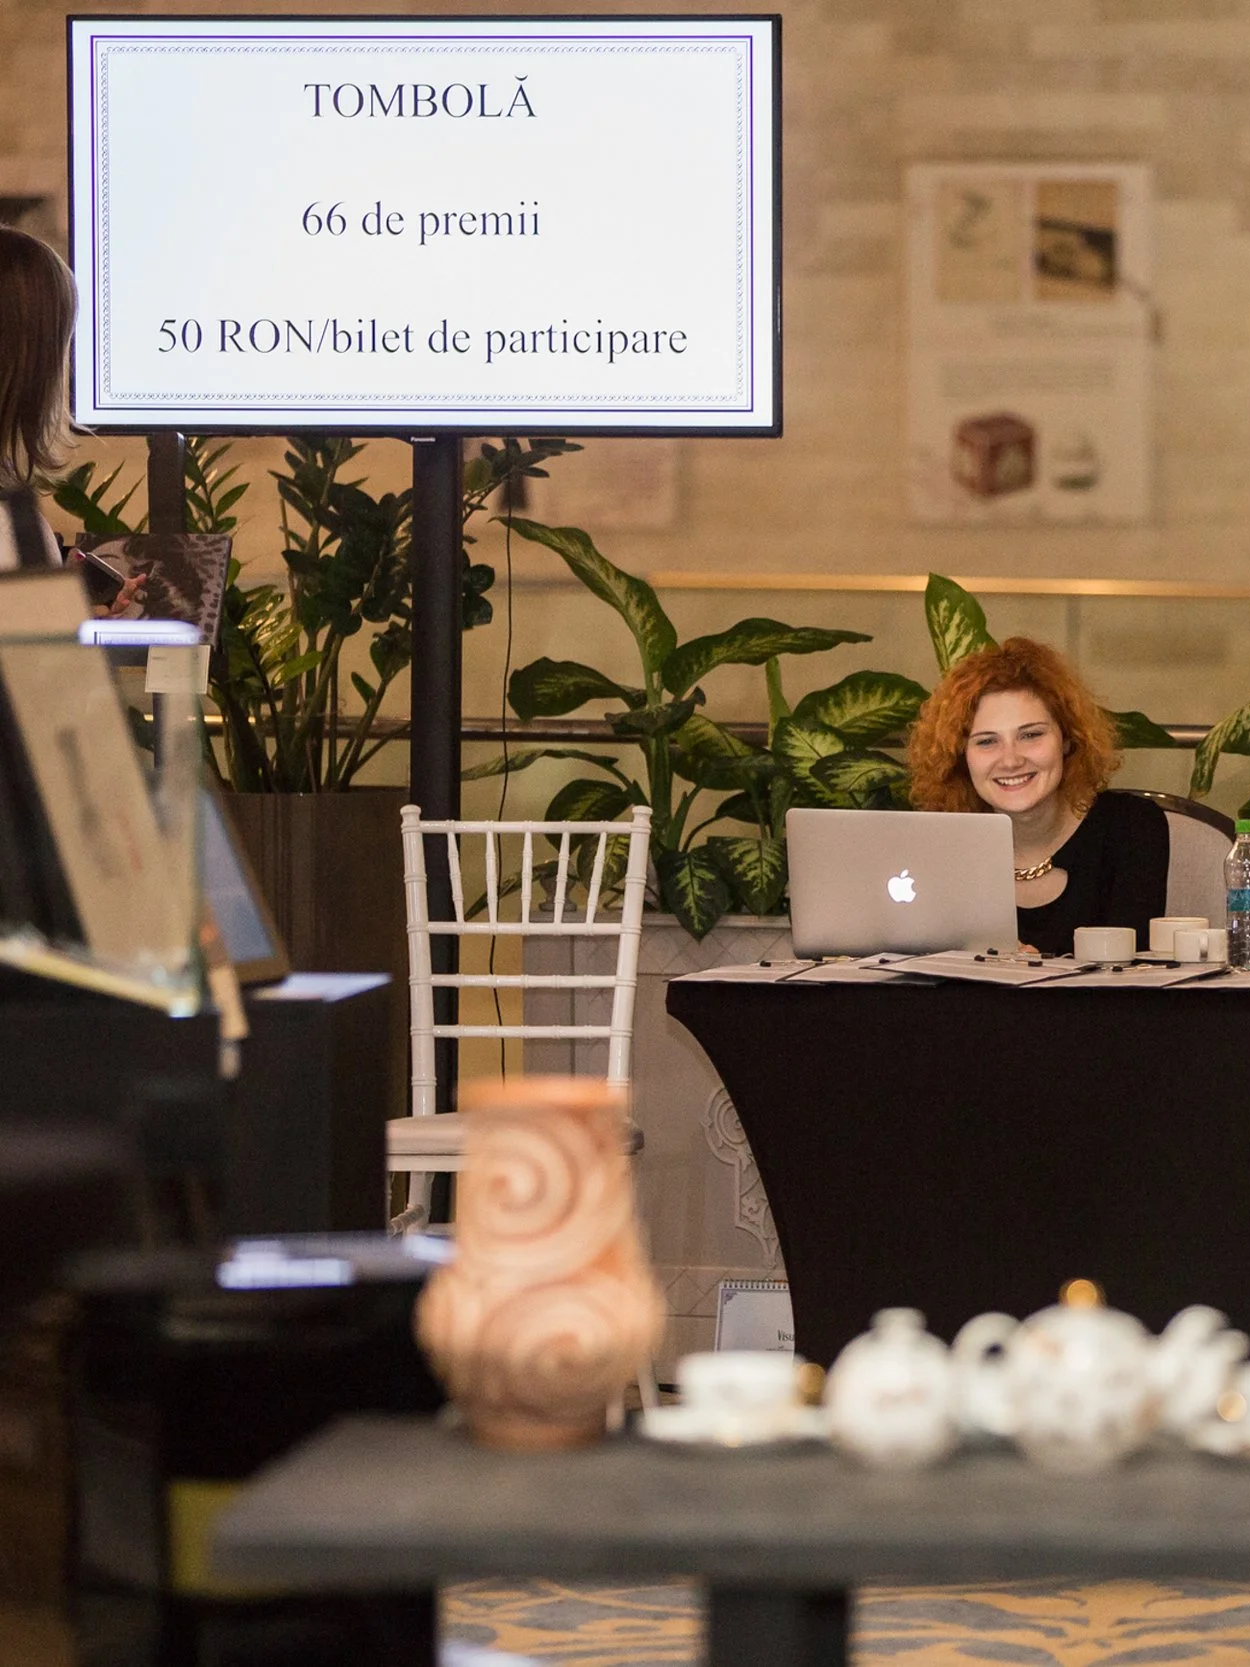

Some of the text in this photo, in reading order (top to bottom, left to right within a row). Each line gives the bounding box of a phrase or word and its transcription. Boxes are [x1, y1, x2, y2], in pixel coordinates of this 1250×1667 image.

[303, 75, 536, 119] TOMBOLĂ
[301, 201, 541, 246] 66 de premii
[157, 317, 688, 364] 50 RON/bilet de participare
